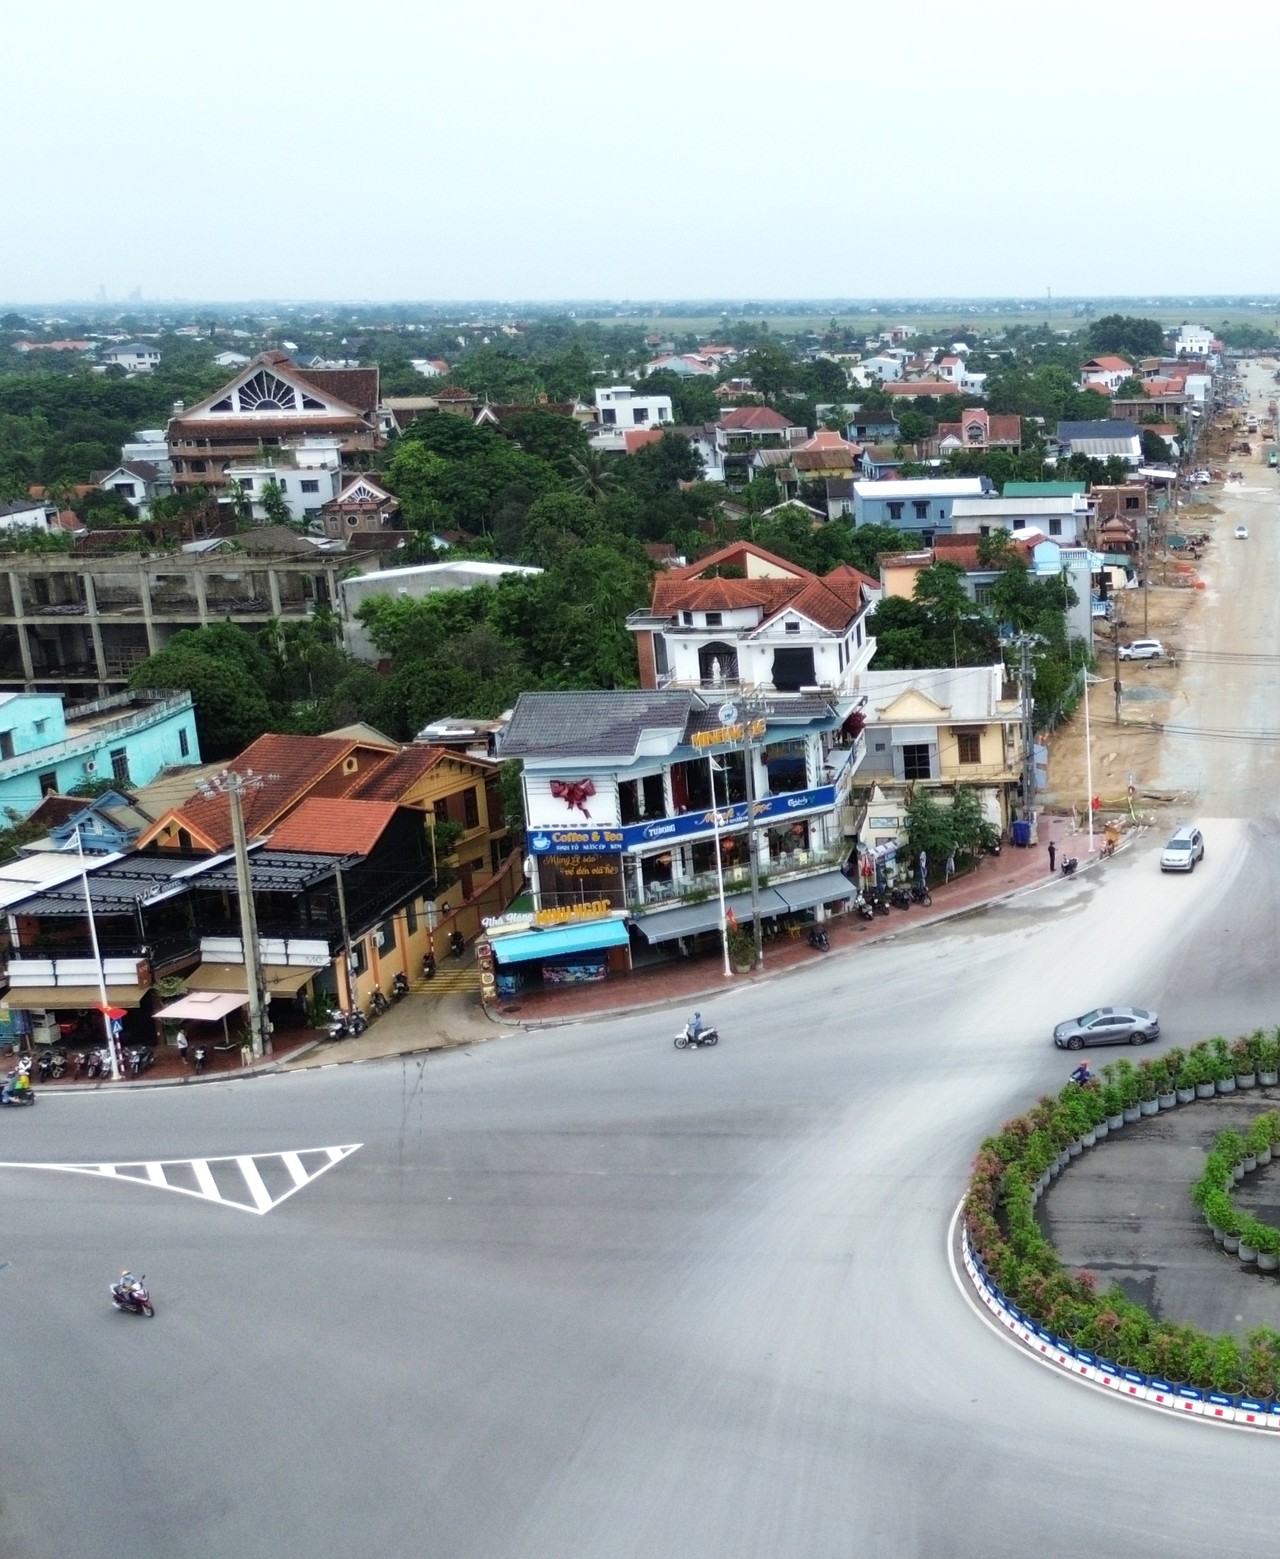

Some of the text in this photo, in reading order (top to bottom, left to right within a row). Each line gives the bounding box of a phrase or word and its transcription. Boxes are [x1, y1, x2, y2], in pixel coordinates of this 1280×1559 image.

[648, 823, 676, 837] TUBORG
[551, 831, 624, 843] Coffee & Tea
